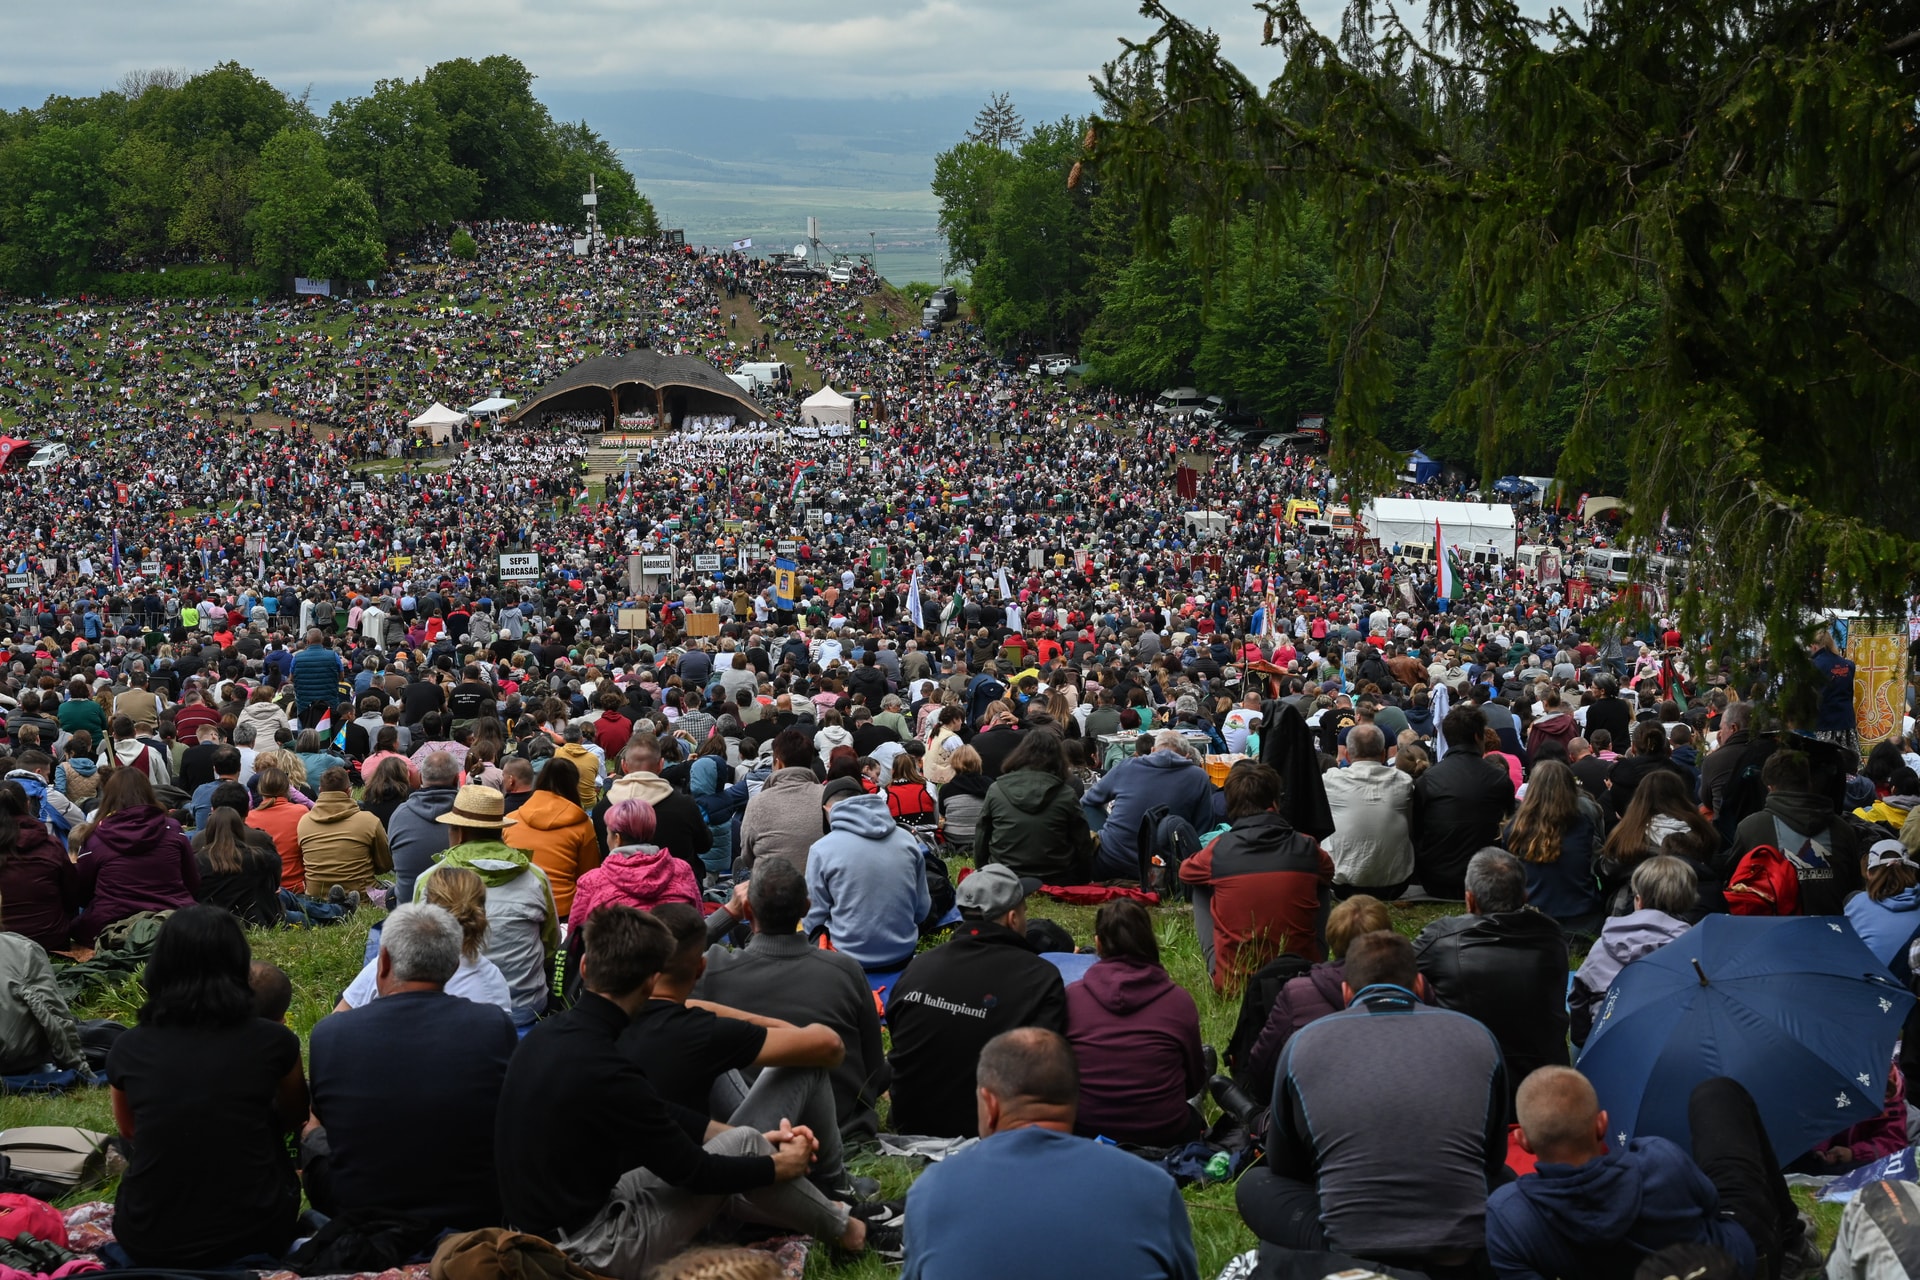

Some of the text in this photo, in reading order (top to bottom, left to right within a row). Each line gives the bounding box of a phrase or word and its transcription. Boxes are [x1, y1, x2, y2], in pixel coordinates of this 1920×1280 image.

[510, 557, 529, 565] SEPSI
[643, 559, 671, 569] HÁROMSZÉK
[501, 566, 538, 576] BARCASÁG
[923, 993, 987, 1019] Italimpianti
